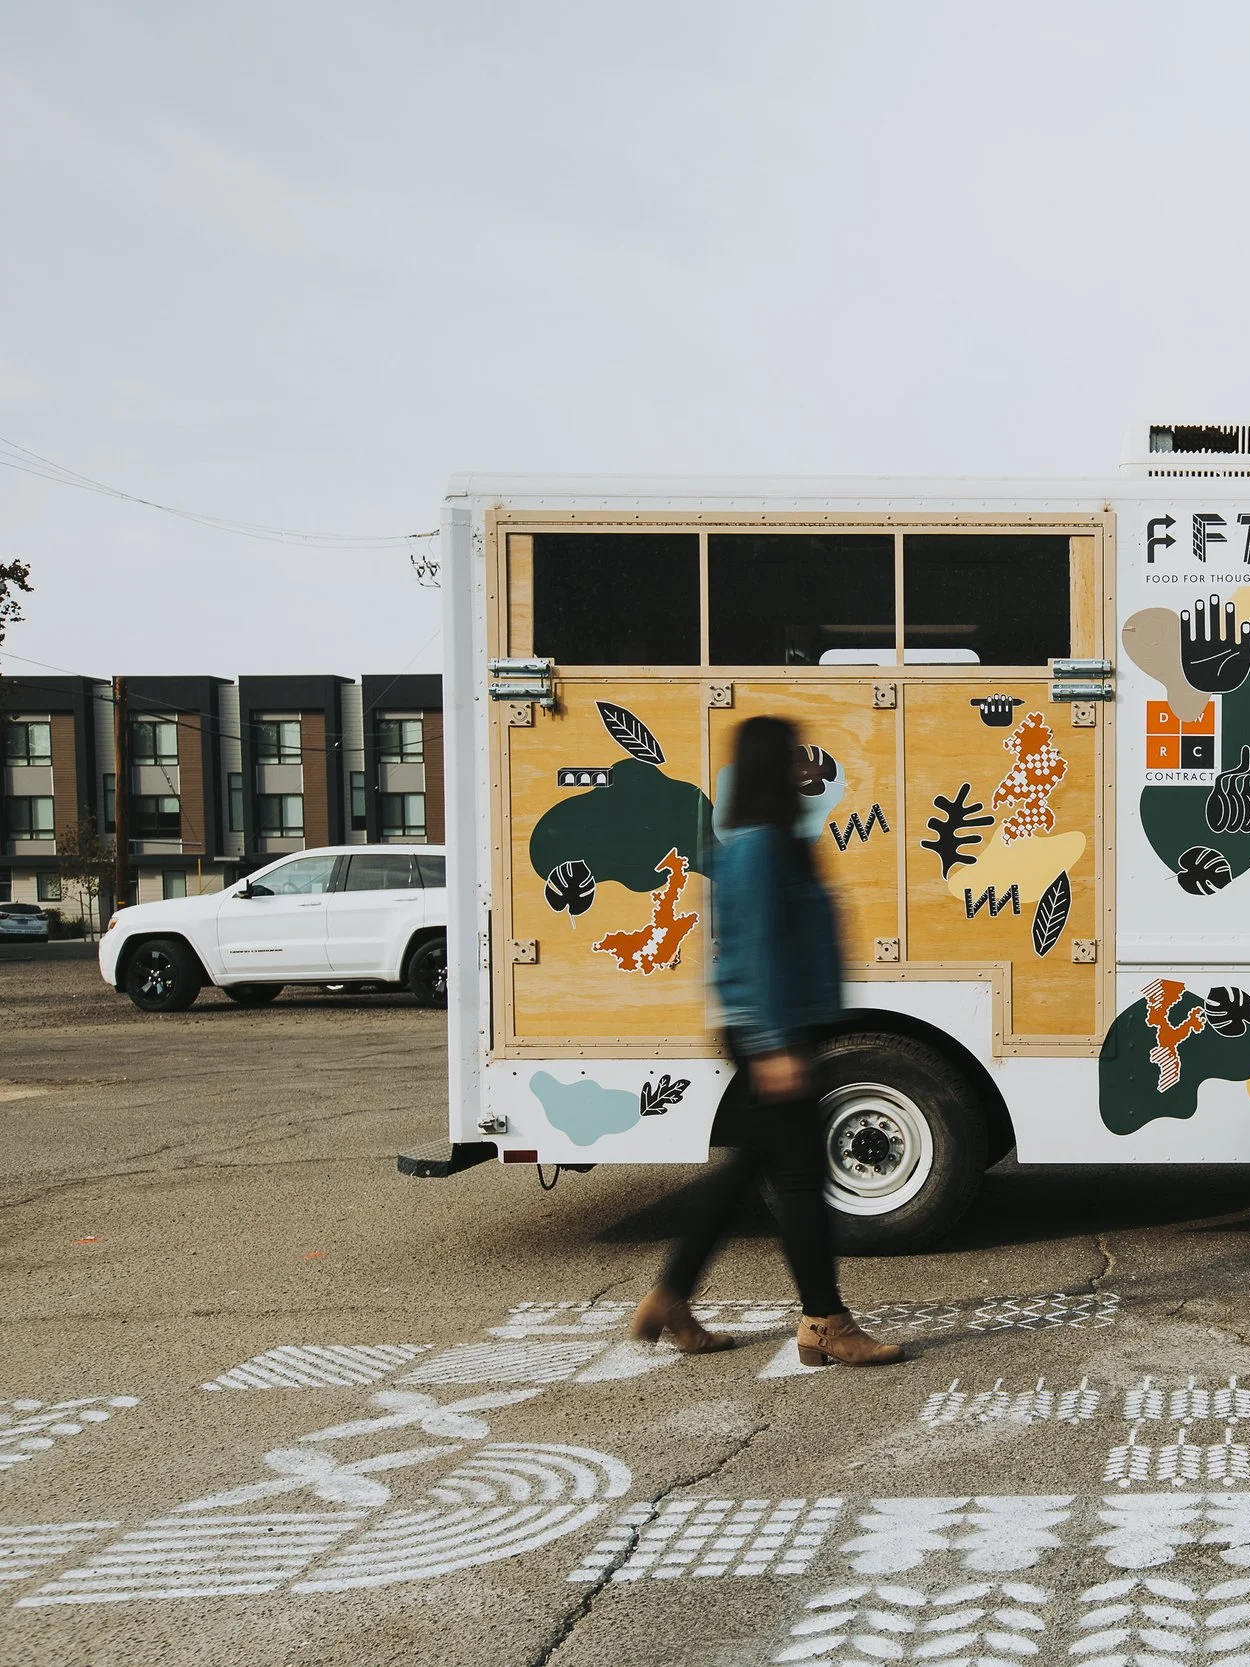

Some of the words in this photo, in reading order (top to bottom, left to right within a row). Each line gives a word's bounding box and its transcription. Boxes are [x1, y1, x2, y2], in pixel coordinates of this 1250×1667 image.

[1146, 574, 1179, 584] FOOD
[1183, 574, 1206, 584] FOR
[1159, 713, 1169, 723] D
[1160, 746, 1167, 757] R
[1193, 746, 1202, 757] C
[1145, 772, 1214, 781] CONTRACT
